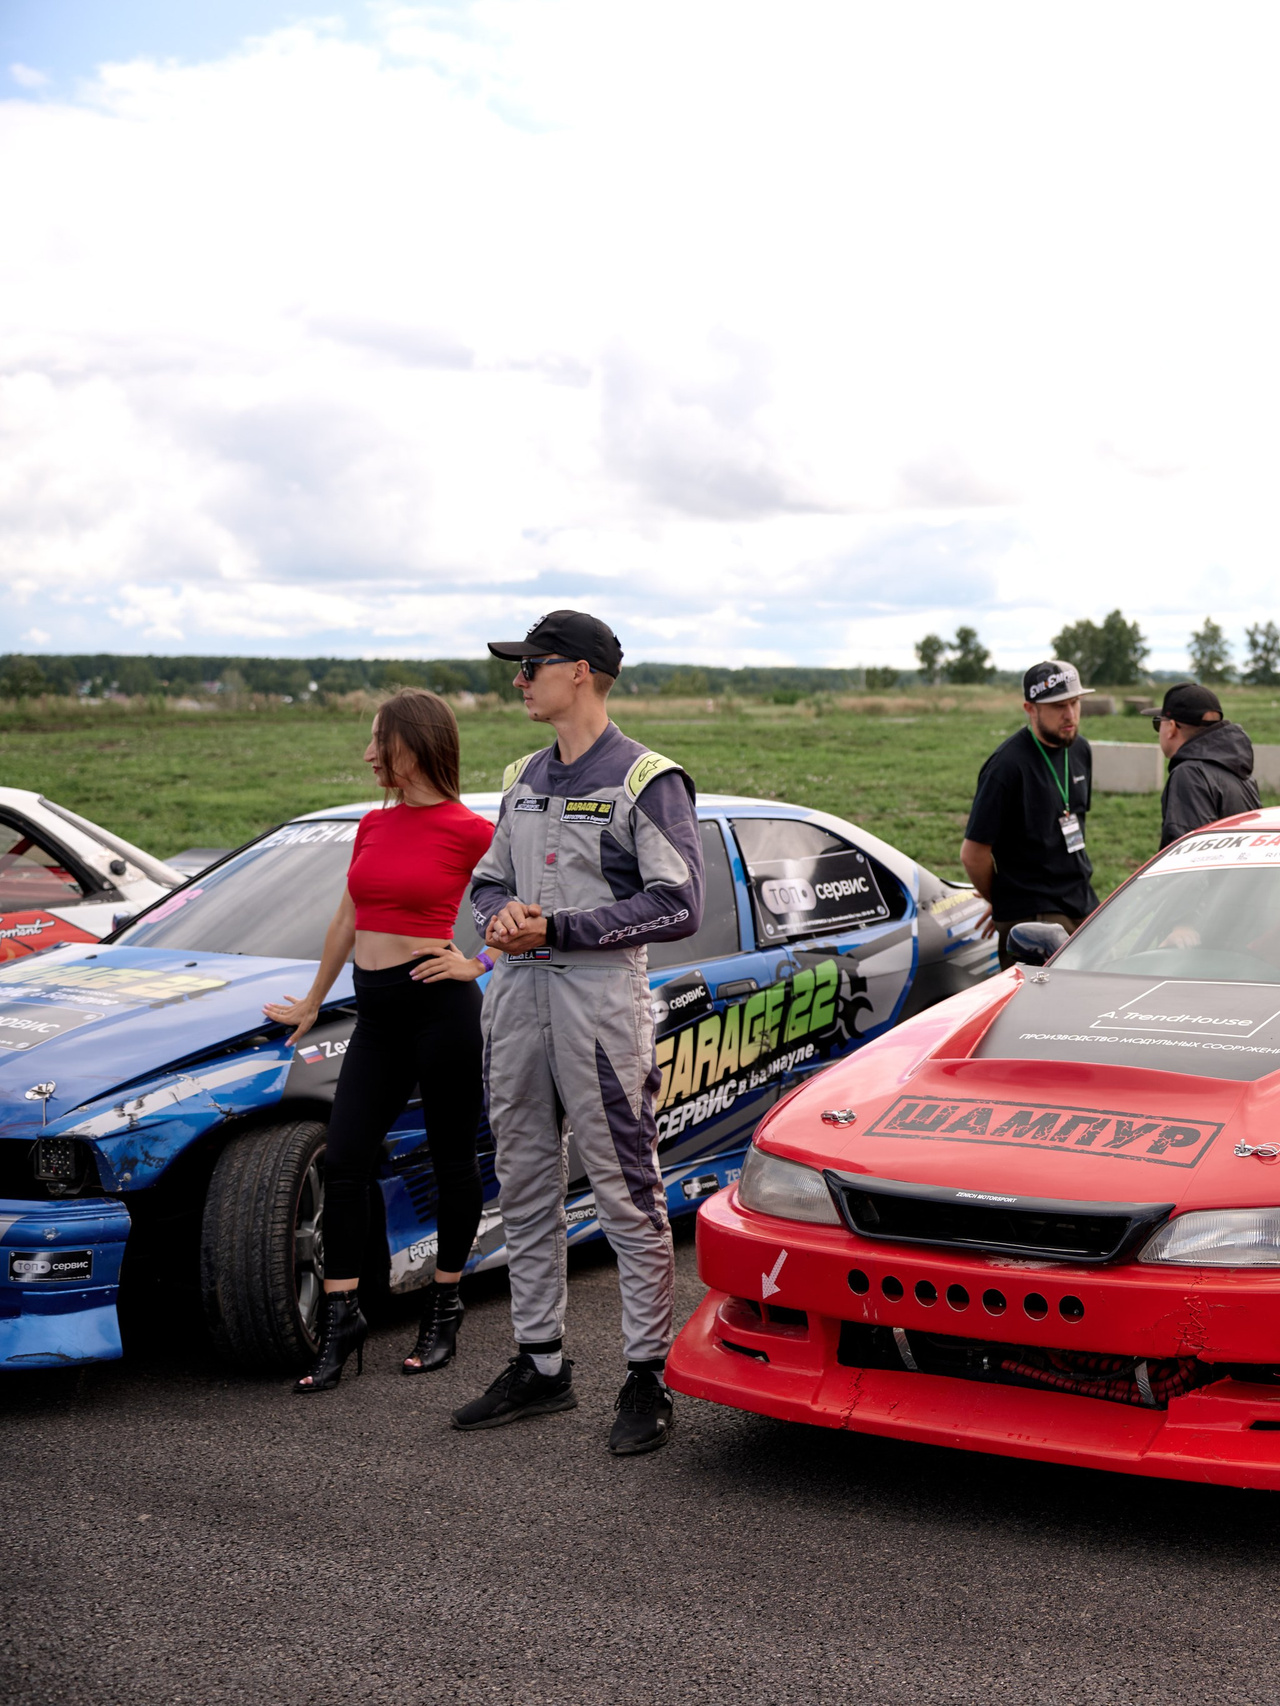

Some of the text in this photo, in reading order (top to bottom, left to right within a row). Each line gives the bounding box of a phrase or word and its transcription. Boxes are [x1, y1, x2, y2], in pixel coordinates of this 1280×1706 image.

[566, 802, 611, 813] GARAGE 22
[1169, 835, 1250, 857] КУБОК
[815, 876, 870, 902] сервис
[669, 986, 706, 1010] сервис
[783, 959, 838, 1043] 22
[1098, 1011, 1254, 1027] A. TrendHouse
[1018, 1033, 1119, 1043] ПРОИЗВОДСТВО
[1119, 1037, 1201, 1048] МОДУЛЬНЫХ
[883, 1102, 1202, 1155] ШАМПУР
[955, 1191, 1017, 1203] ZENICH MOTORSPORT
[52, 1261, 89, 1271] сервис
